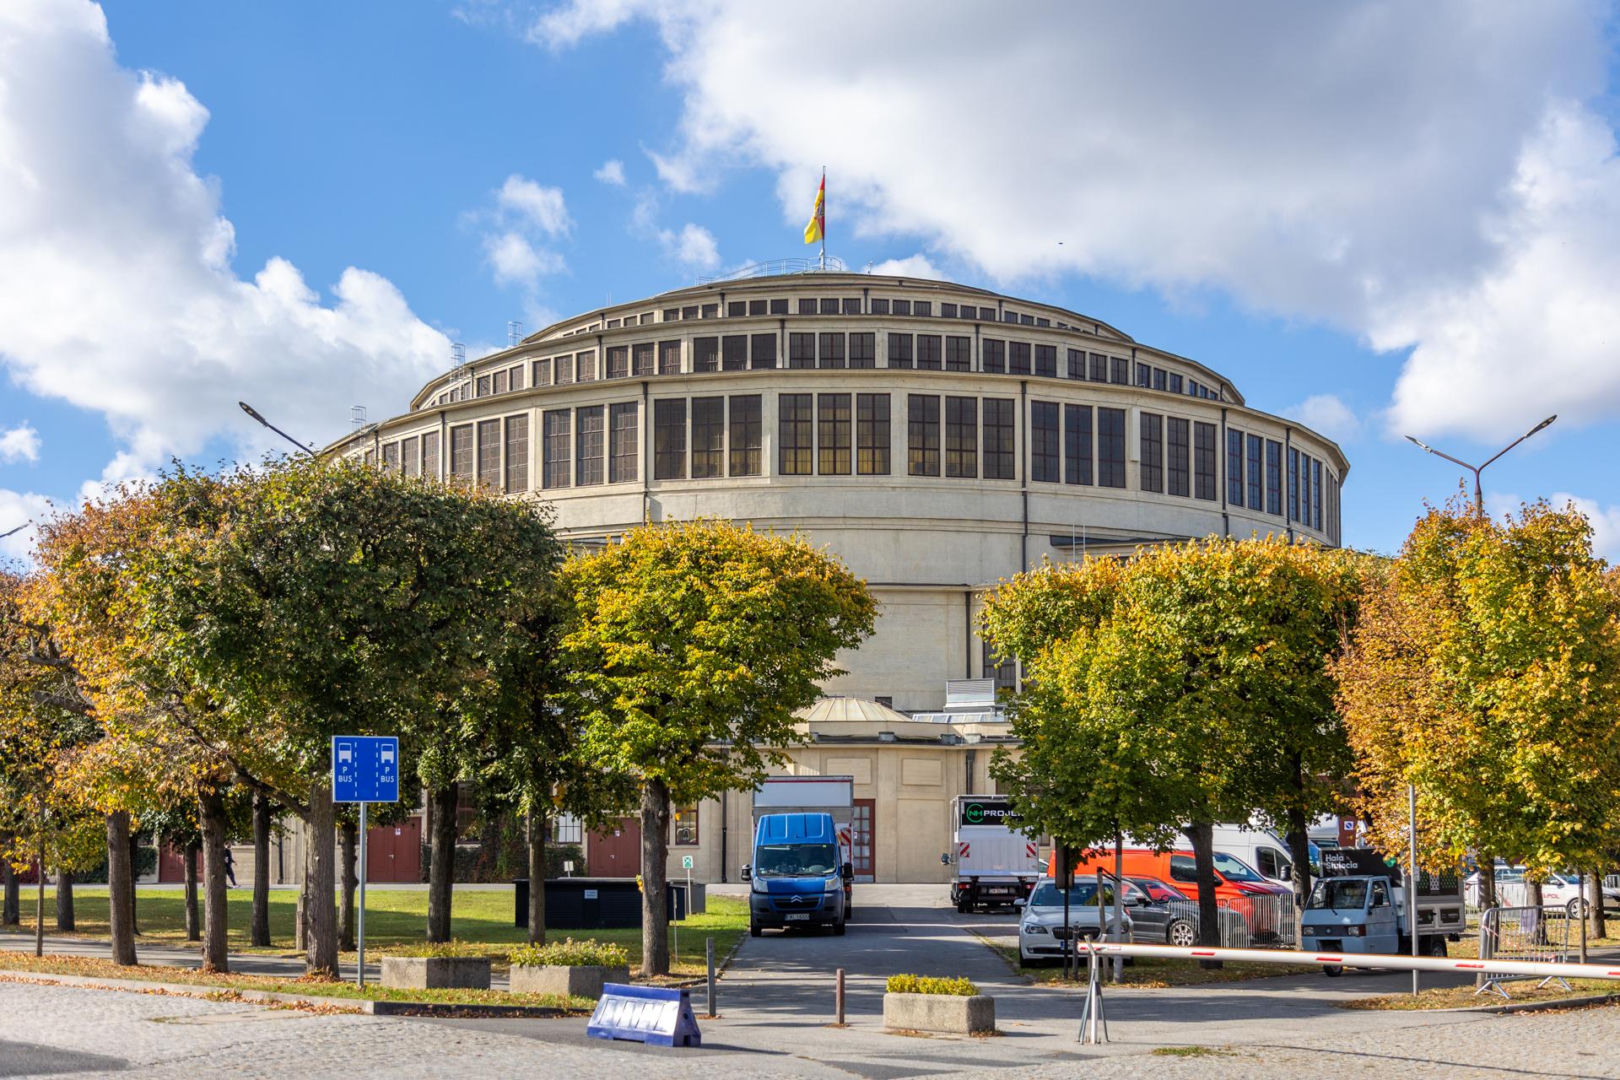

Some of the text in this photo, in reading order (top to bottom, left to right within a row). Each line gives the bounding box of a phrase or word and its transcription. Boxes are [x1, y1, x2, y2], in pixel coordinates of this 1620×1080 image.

[342, 766, 348, 774] P
[385, 766, 390, 774] P
[338, 775, 353, 783] BUS
[380, 775, 394, 783] BUS
[1325, 853, 1344, 861] Hala
